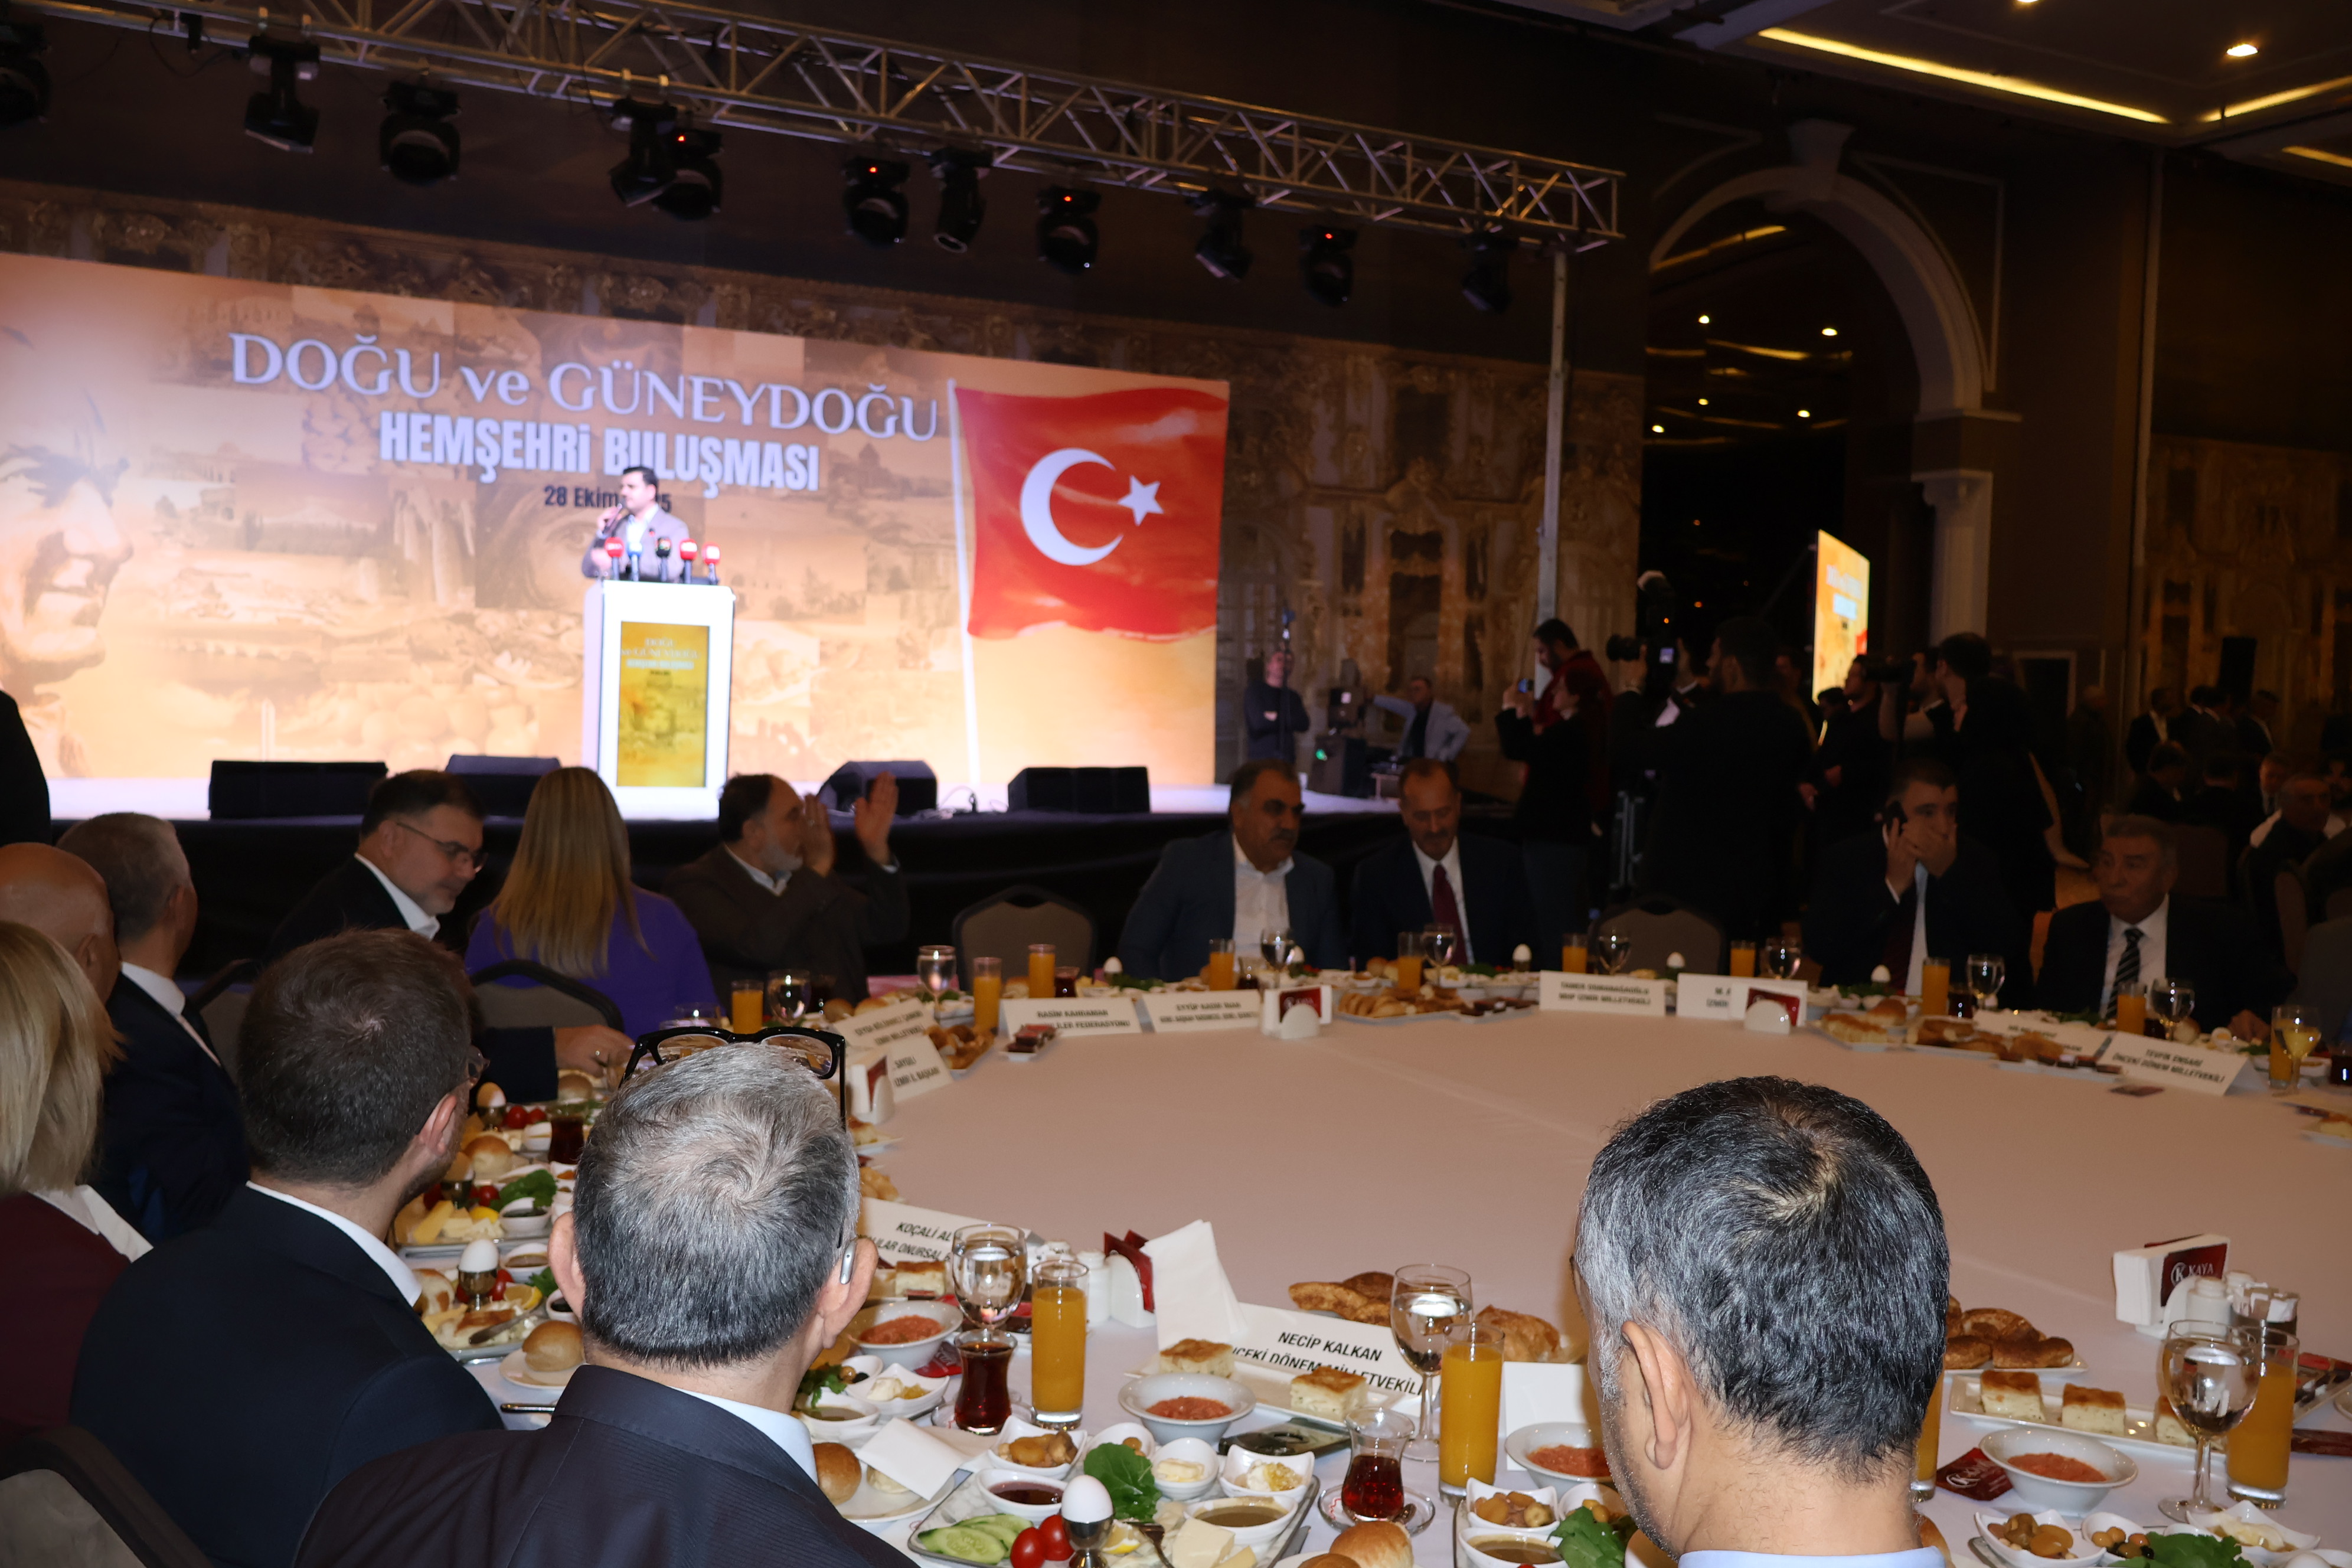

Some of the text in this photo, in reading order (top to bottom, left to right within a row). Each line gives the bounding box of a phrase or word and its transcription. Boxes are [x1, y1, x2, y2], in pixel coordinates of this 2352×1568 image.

[228, 332, 937, 442] DOĞU ve GÜNEYDOĞU
[604, 427, 819, 499] BULUŞMASI
[544, 485, 619, 508] 28 Ekim
[896, 1221, 940, 1238] KOÇALİ
[897, 1242, 942, 1260] ONURSAL
[2188, 1262, 2213, 1276] KAYA
[1278, 1331, 1383, 1362] NECİP KALKAN
